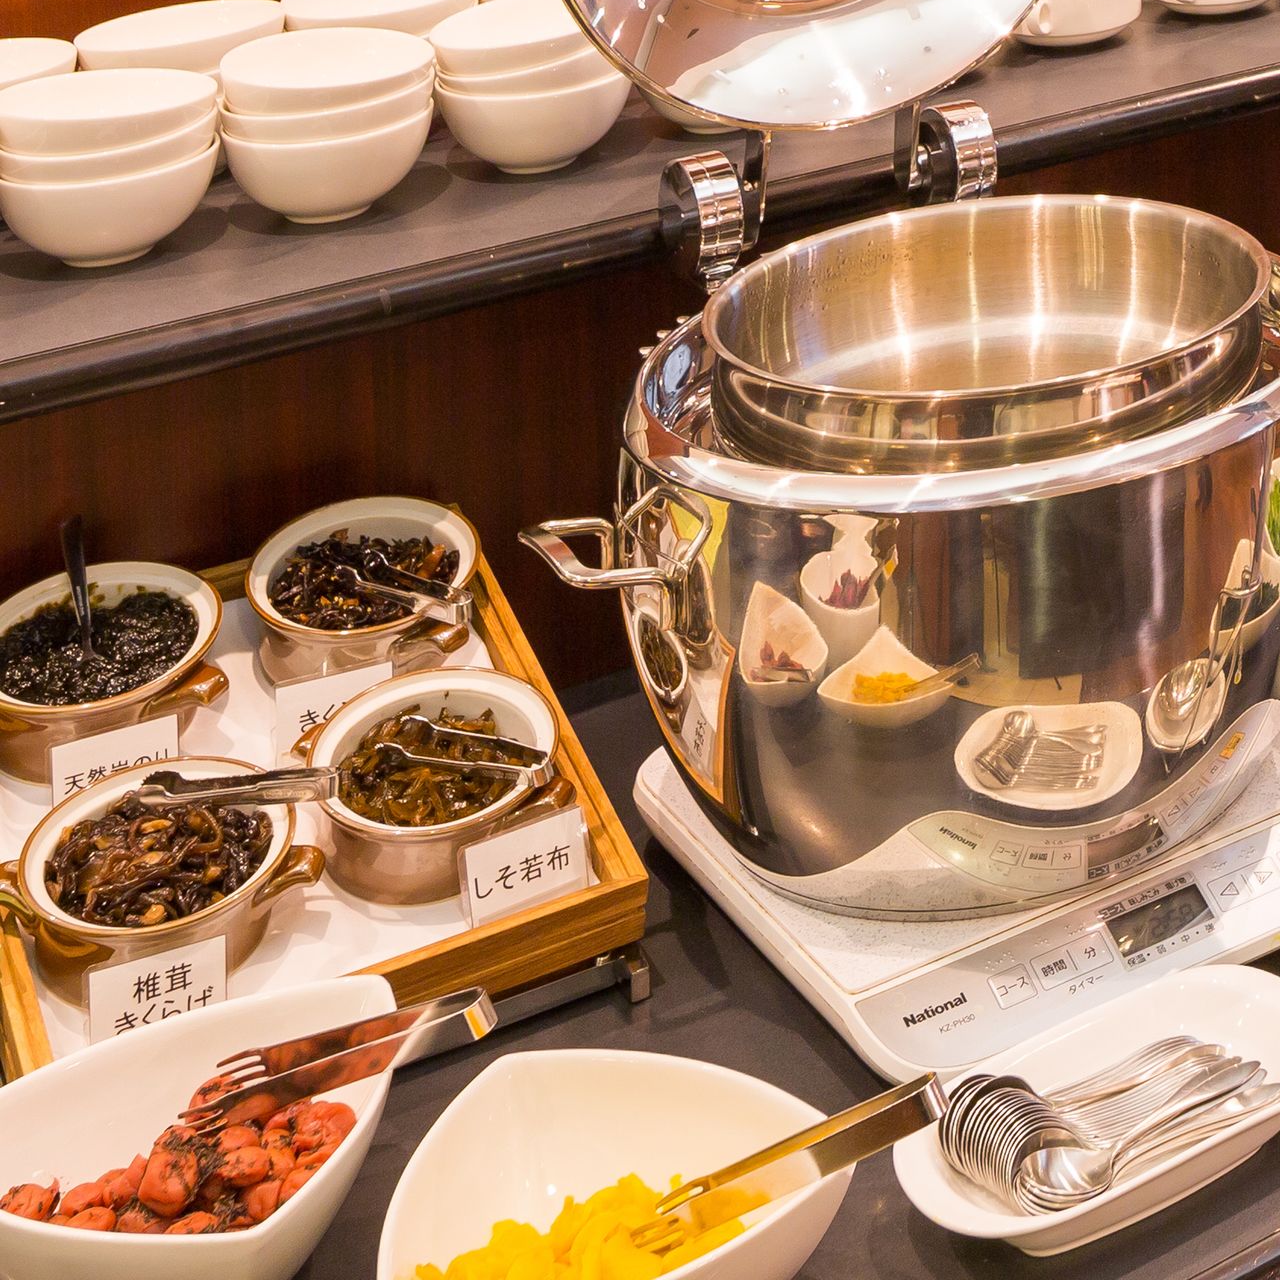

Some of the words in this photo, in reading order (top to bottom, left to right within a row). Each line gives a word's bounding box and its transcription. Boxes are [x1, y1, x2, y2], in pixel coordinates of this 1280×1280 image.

[474, 845, 571, 899] しそ若布
[1041, 958, 1068, 977] 時間
[1083, 946, 1097, 960] 分
[133, 963, 193, 1004] 椎茸
[995, 976, 1030, 997] コース
[1067, 974, 1105, 995] タイマー
[114, 985, 214, 1035] きくらげ
[902, 992, 968, 1028] National
[938, 1013, 976, 1034] KZ-PH30
